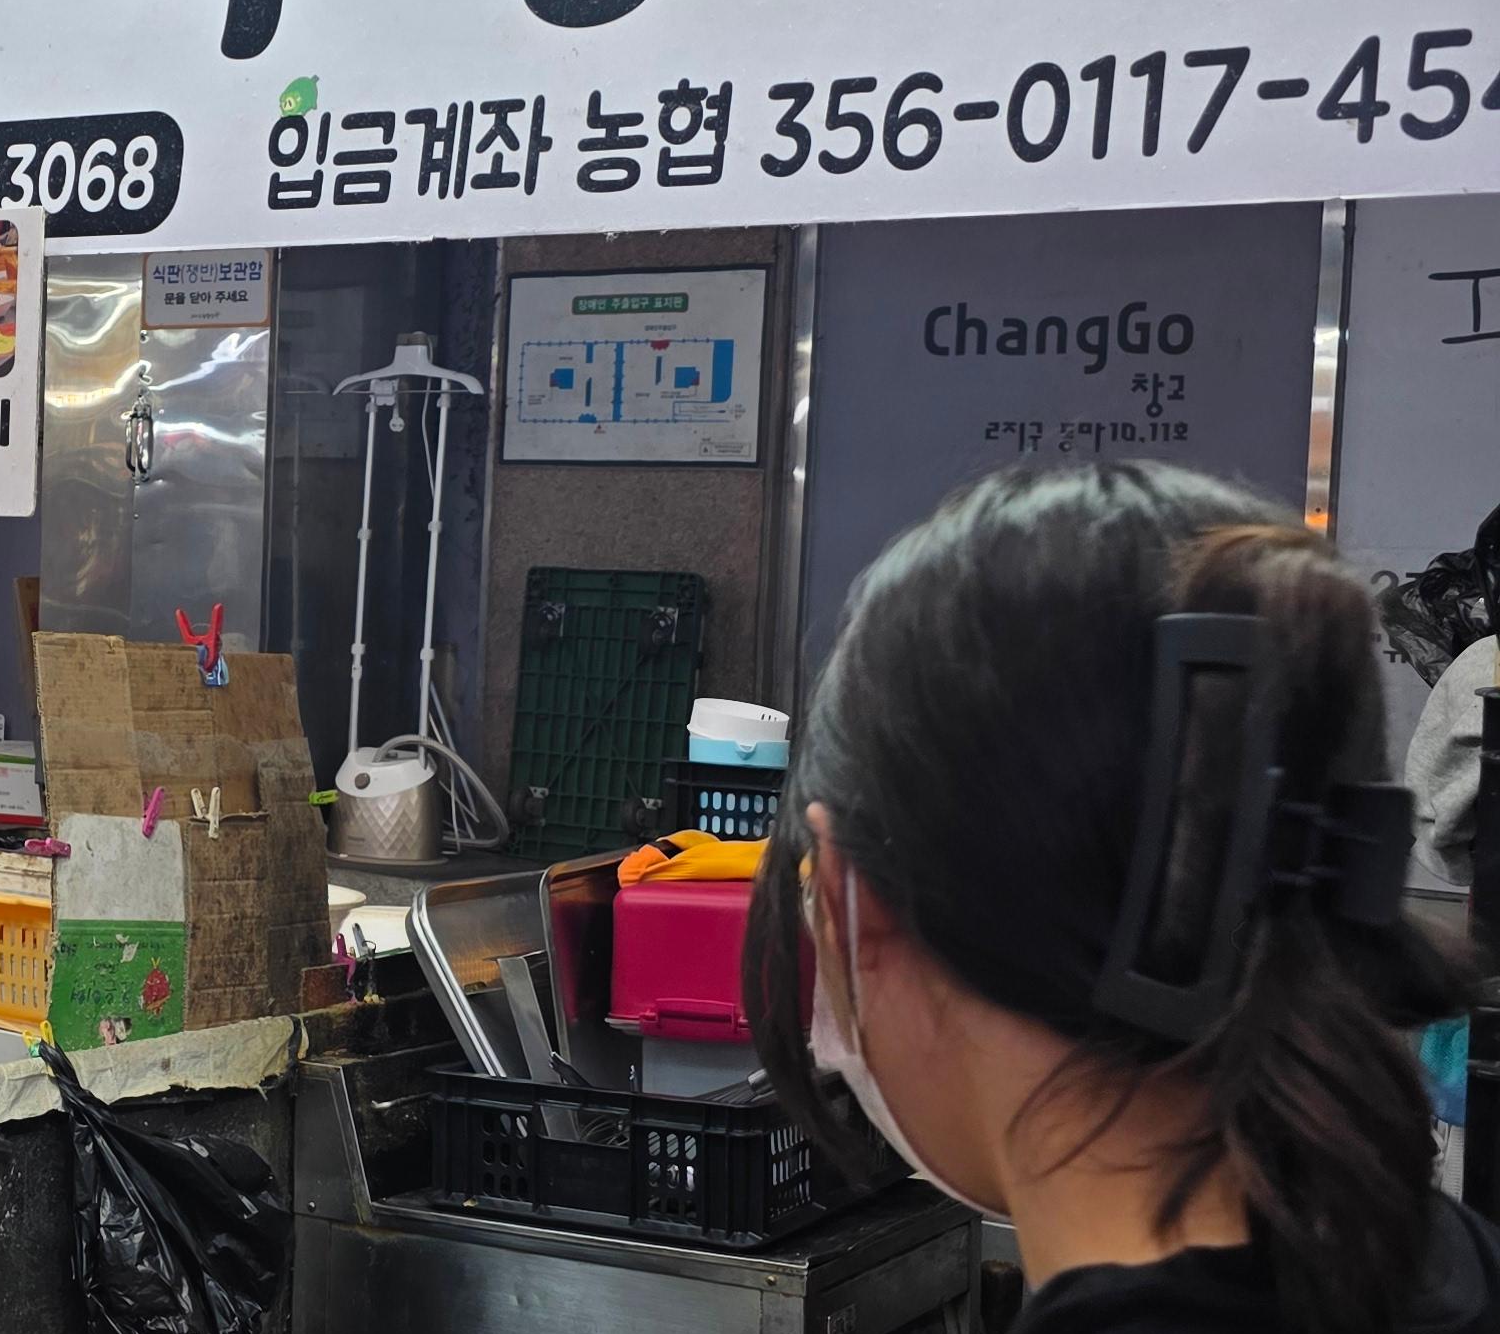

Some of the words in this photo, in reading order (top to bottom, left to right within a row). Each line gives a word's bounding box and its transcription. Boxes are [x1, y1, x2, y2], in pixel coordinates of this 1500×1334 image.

[268, 95, 553, 210] 입금계좌
[575, 78, 731, 194] 농협
[760, 29, 1500, 177] 356-0117-45
[164, 292, 186, 305] 문을
[190, 291, 211, 304] 닫아
[215, 290, 249, 303] 주세요
[923, 301, 1195, 374] ChangGo
[1131, 373, 1185, 418] 창고
